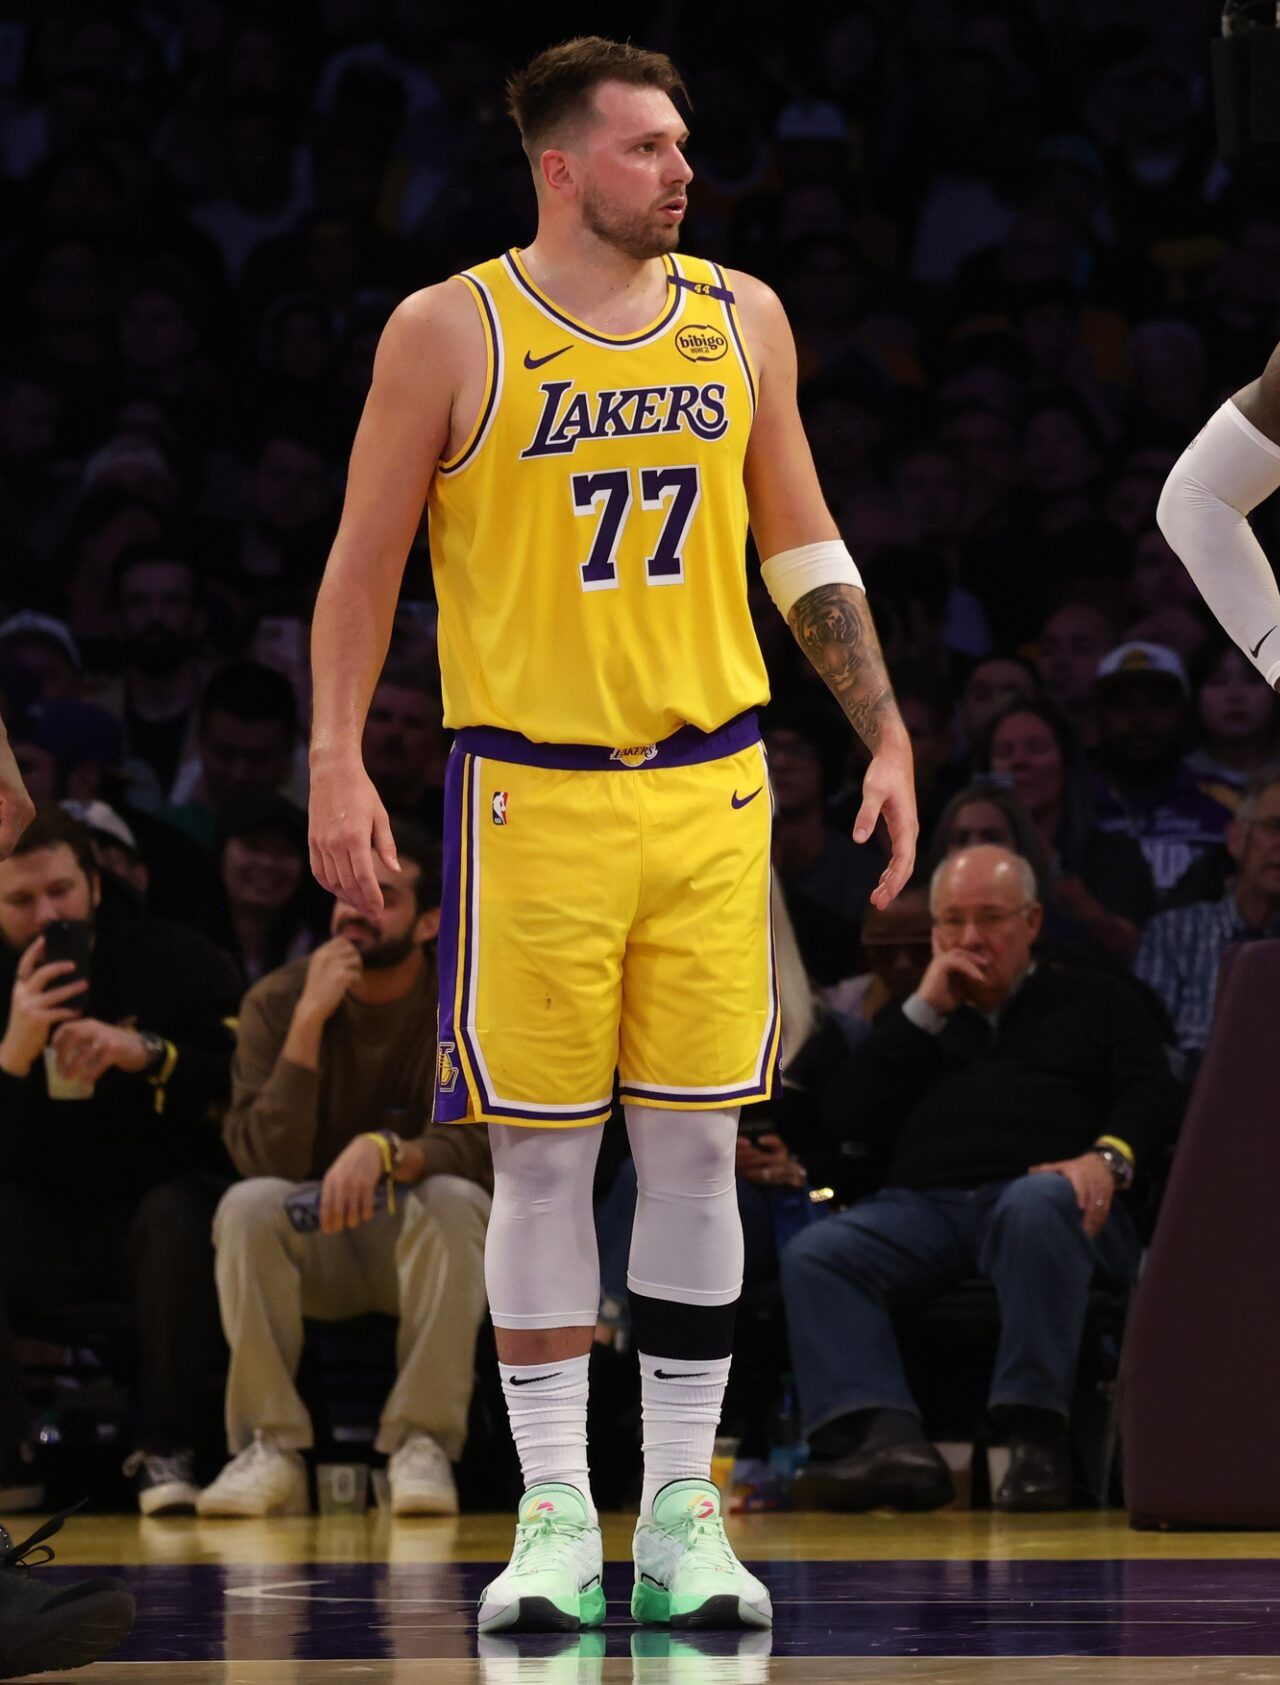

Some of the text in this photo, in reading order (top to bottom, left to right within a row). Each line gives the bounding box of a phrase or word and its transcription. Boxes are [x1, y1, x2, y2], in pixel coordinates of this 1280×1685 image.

[694, 284, 710, 294] 44
[679, 333, 725, 350] bibigo
[518, 379, 729, 460] LAKERS
[570, 464, 702, 593] 77
